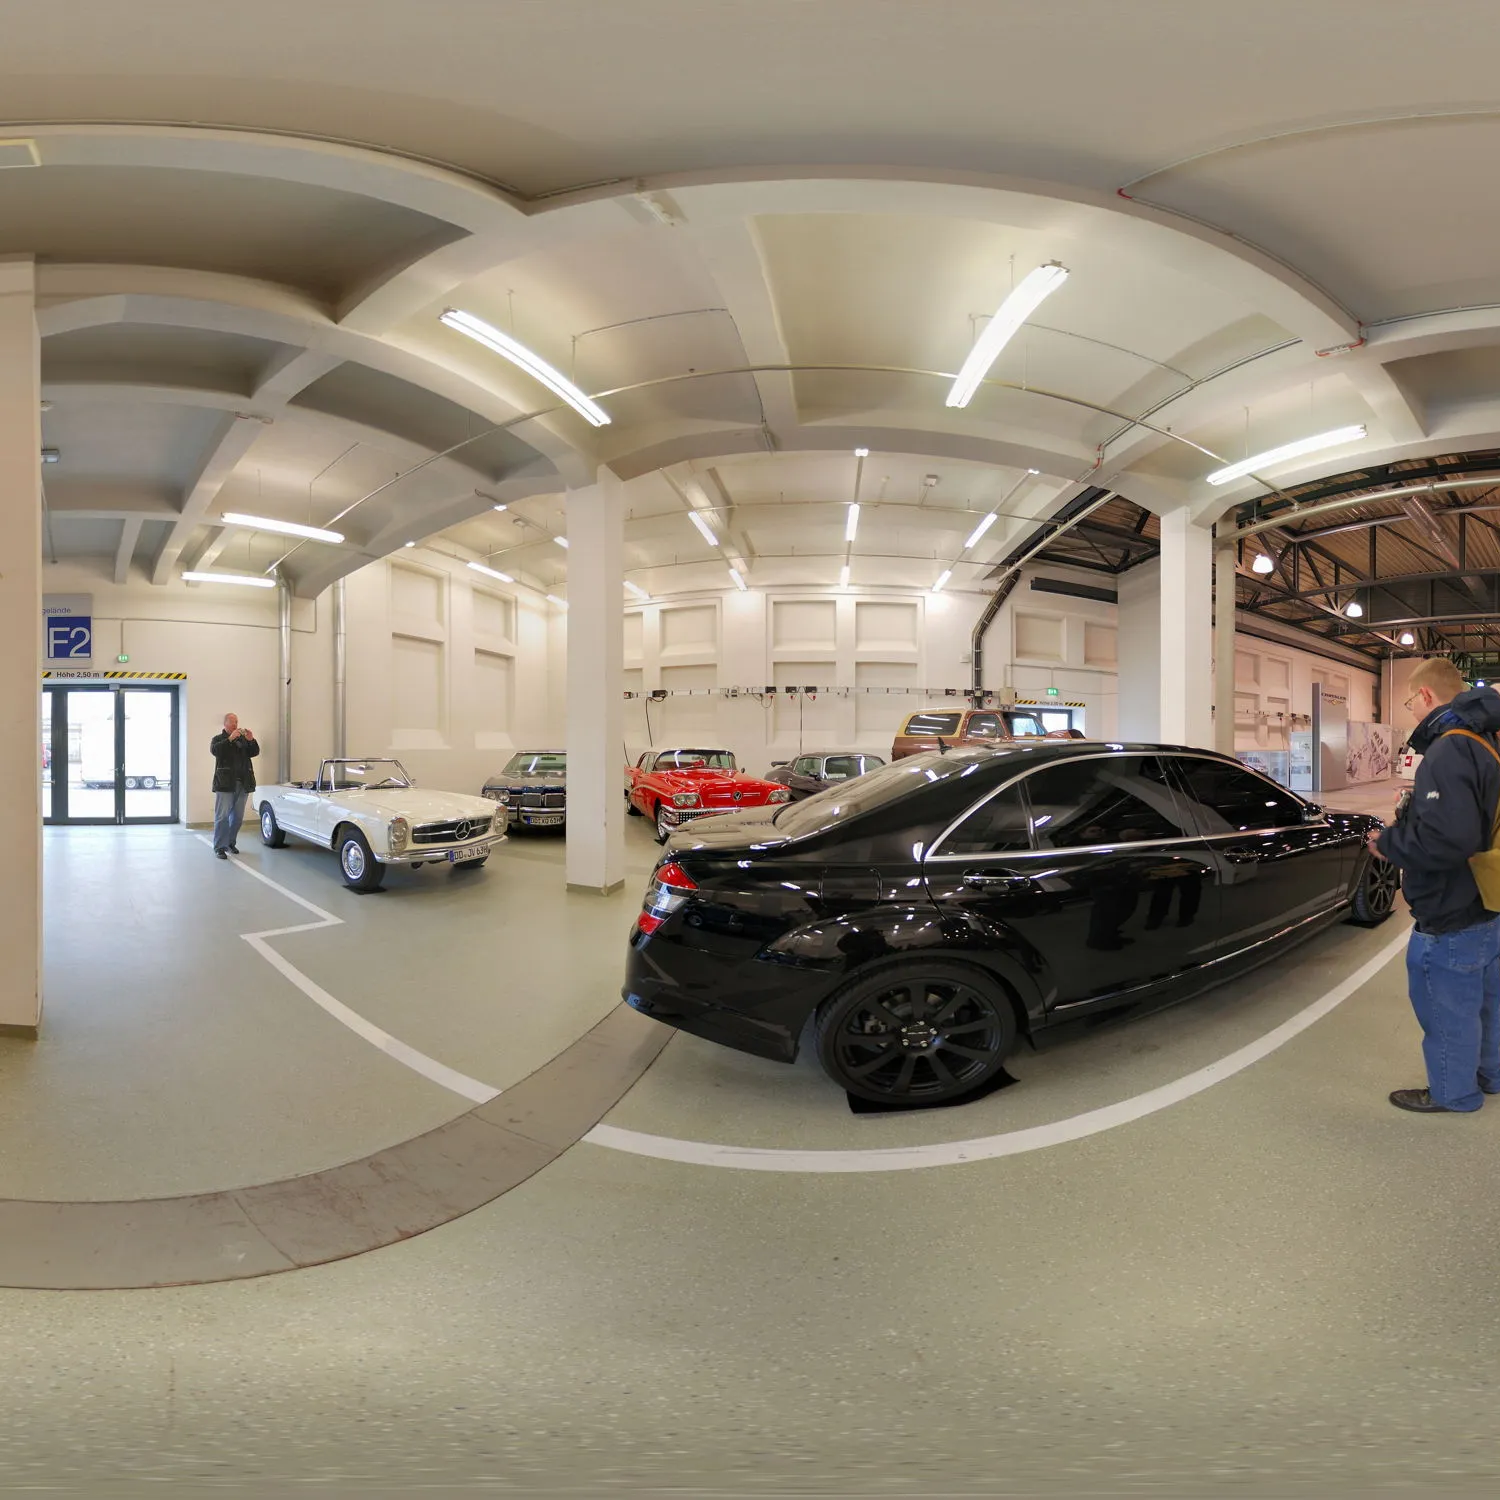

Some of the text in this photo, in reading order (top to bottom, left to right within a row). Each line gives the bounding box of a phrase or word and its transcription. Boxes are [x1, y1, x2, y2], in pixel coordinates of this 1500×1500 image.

[49, 627, 91, 657] F2
[76, 671, 91, 679] 2,50
[454, 850, 464, 860] DD
